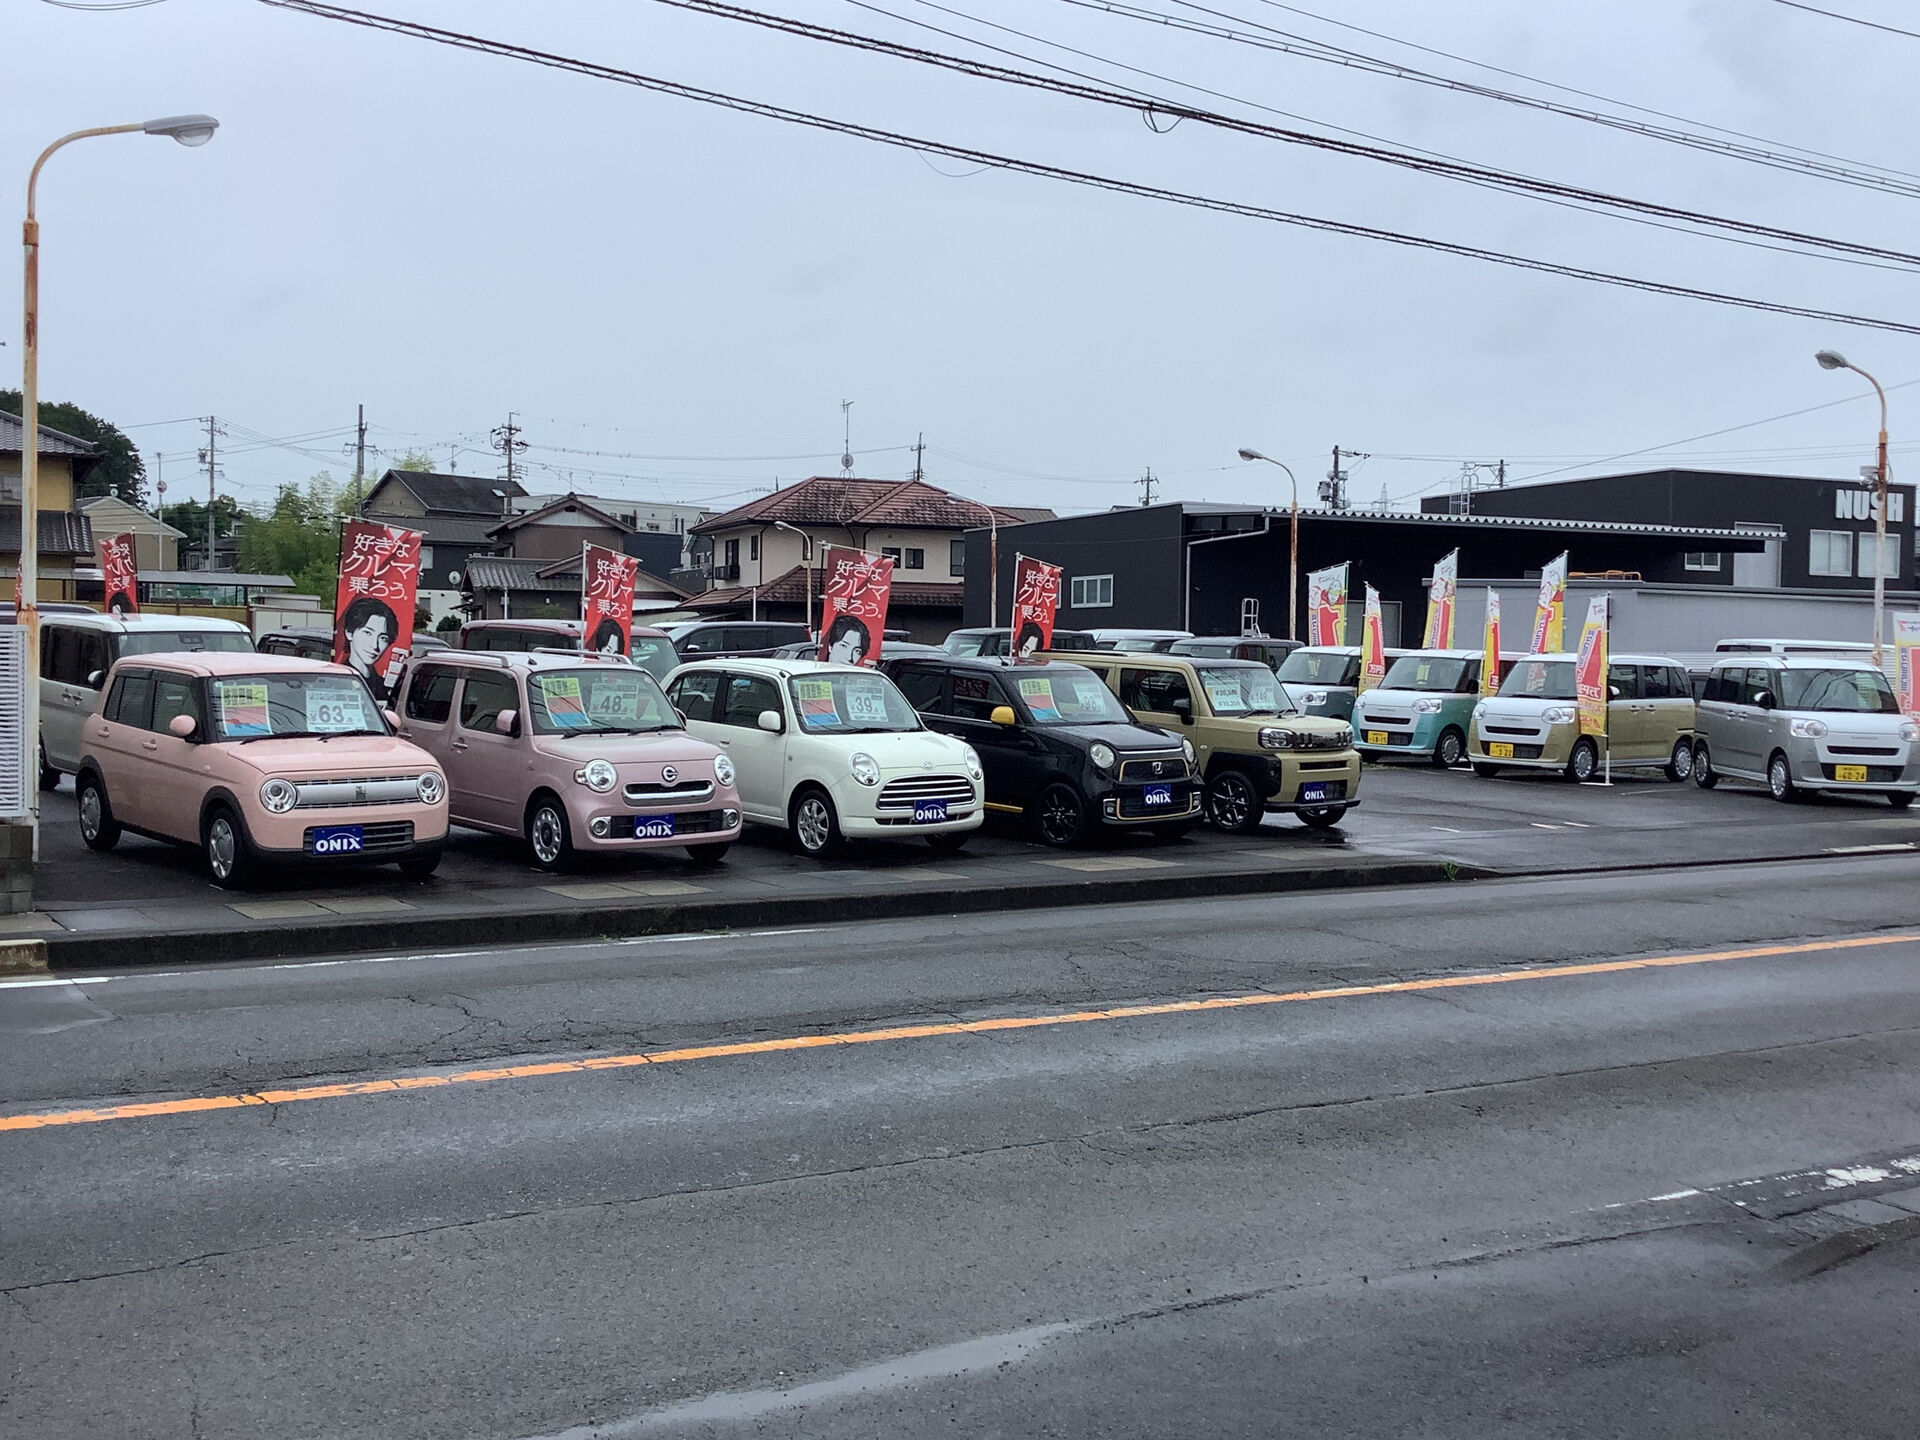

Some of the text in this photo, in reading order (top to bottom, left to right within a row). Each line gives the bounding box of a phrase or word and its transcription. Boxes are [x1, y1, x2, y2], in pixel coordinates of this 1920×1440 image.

[353, 532, 411, 558] 好きな
[343, 550, 416, 580] クルマ
[596, 558, 630, 582] 好きな
[835, 558, 883, 581] 好きな
[347, 575, 409, 601] 乗ろう。
[590, 574, 633, 600] クルマ
[828, 574, 889, 601] クルマ
[1025, 568, 1056, 589] 好きな
[1018, 583, 1057, 607] クルマ
[832, 596, 883, 619] 乗ろう。
[1145, 793, 1171, 804] ONIX
[1304, 790, 1325, 801] ONIX
[915, 808, 946, 820] ONIX
[635, 824, 673, 838] ONIX
[315, 837, 361, 852] ONIX
